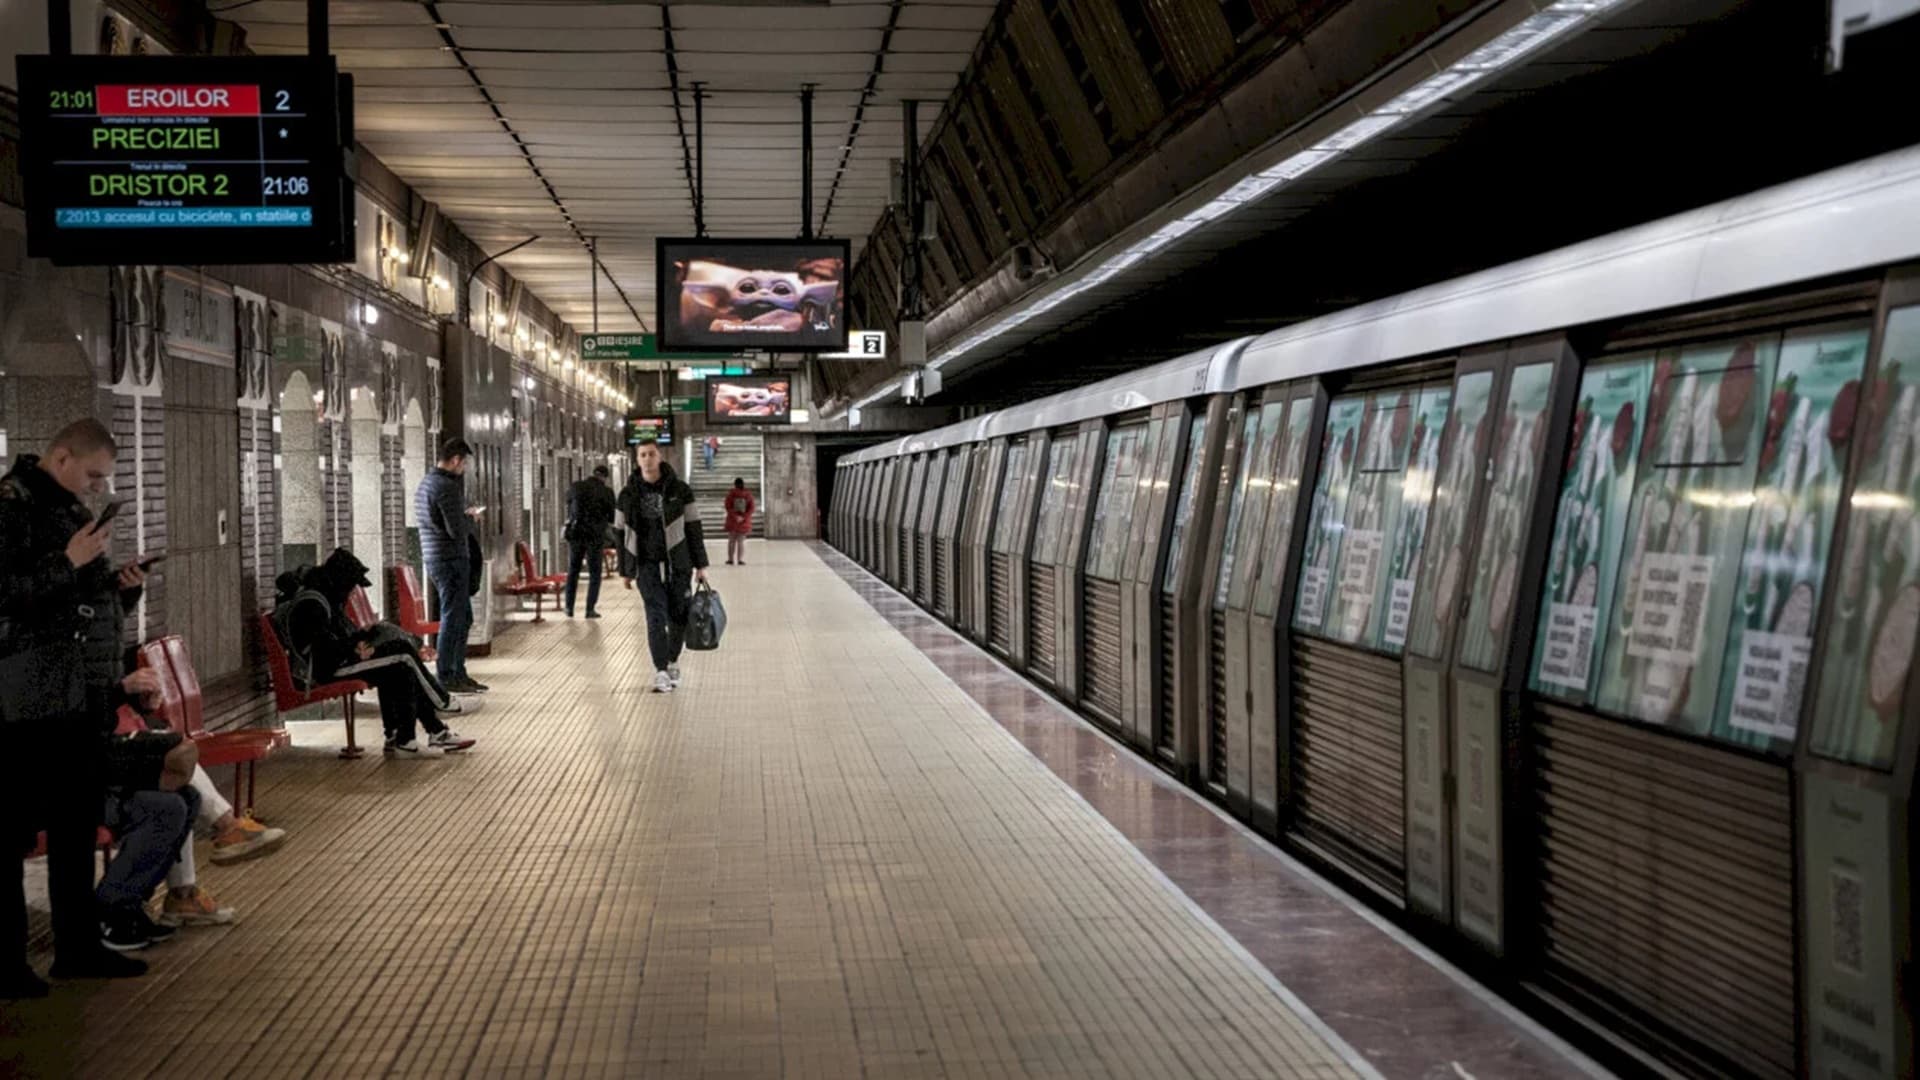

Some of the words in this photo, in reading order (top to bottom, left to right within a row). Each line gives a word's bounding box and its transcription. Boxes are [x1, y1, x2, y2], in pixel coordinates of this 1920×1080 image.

[50, 91, 93, 109] 21:01
[127, 88, 229, 108] EROILOR
[275, 91, 290, 111] 2
[93, 128, 220, 150] PRECIZIEI
[90, 174, 207, 196] DRISTOR
[214, 174, 229, 195] 2
[264, 177, 309, 195] 21:06
[104, 210, 155, 223] accesul
[159, 212, 175, 222] cu
[178, 209, 237, 223] biciclete,
[240, 209, 252, 222] in
[256, 209, 298, 222] statiile
[867, 341, 877, 353] 2
